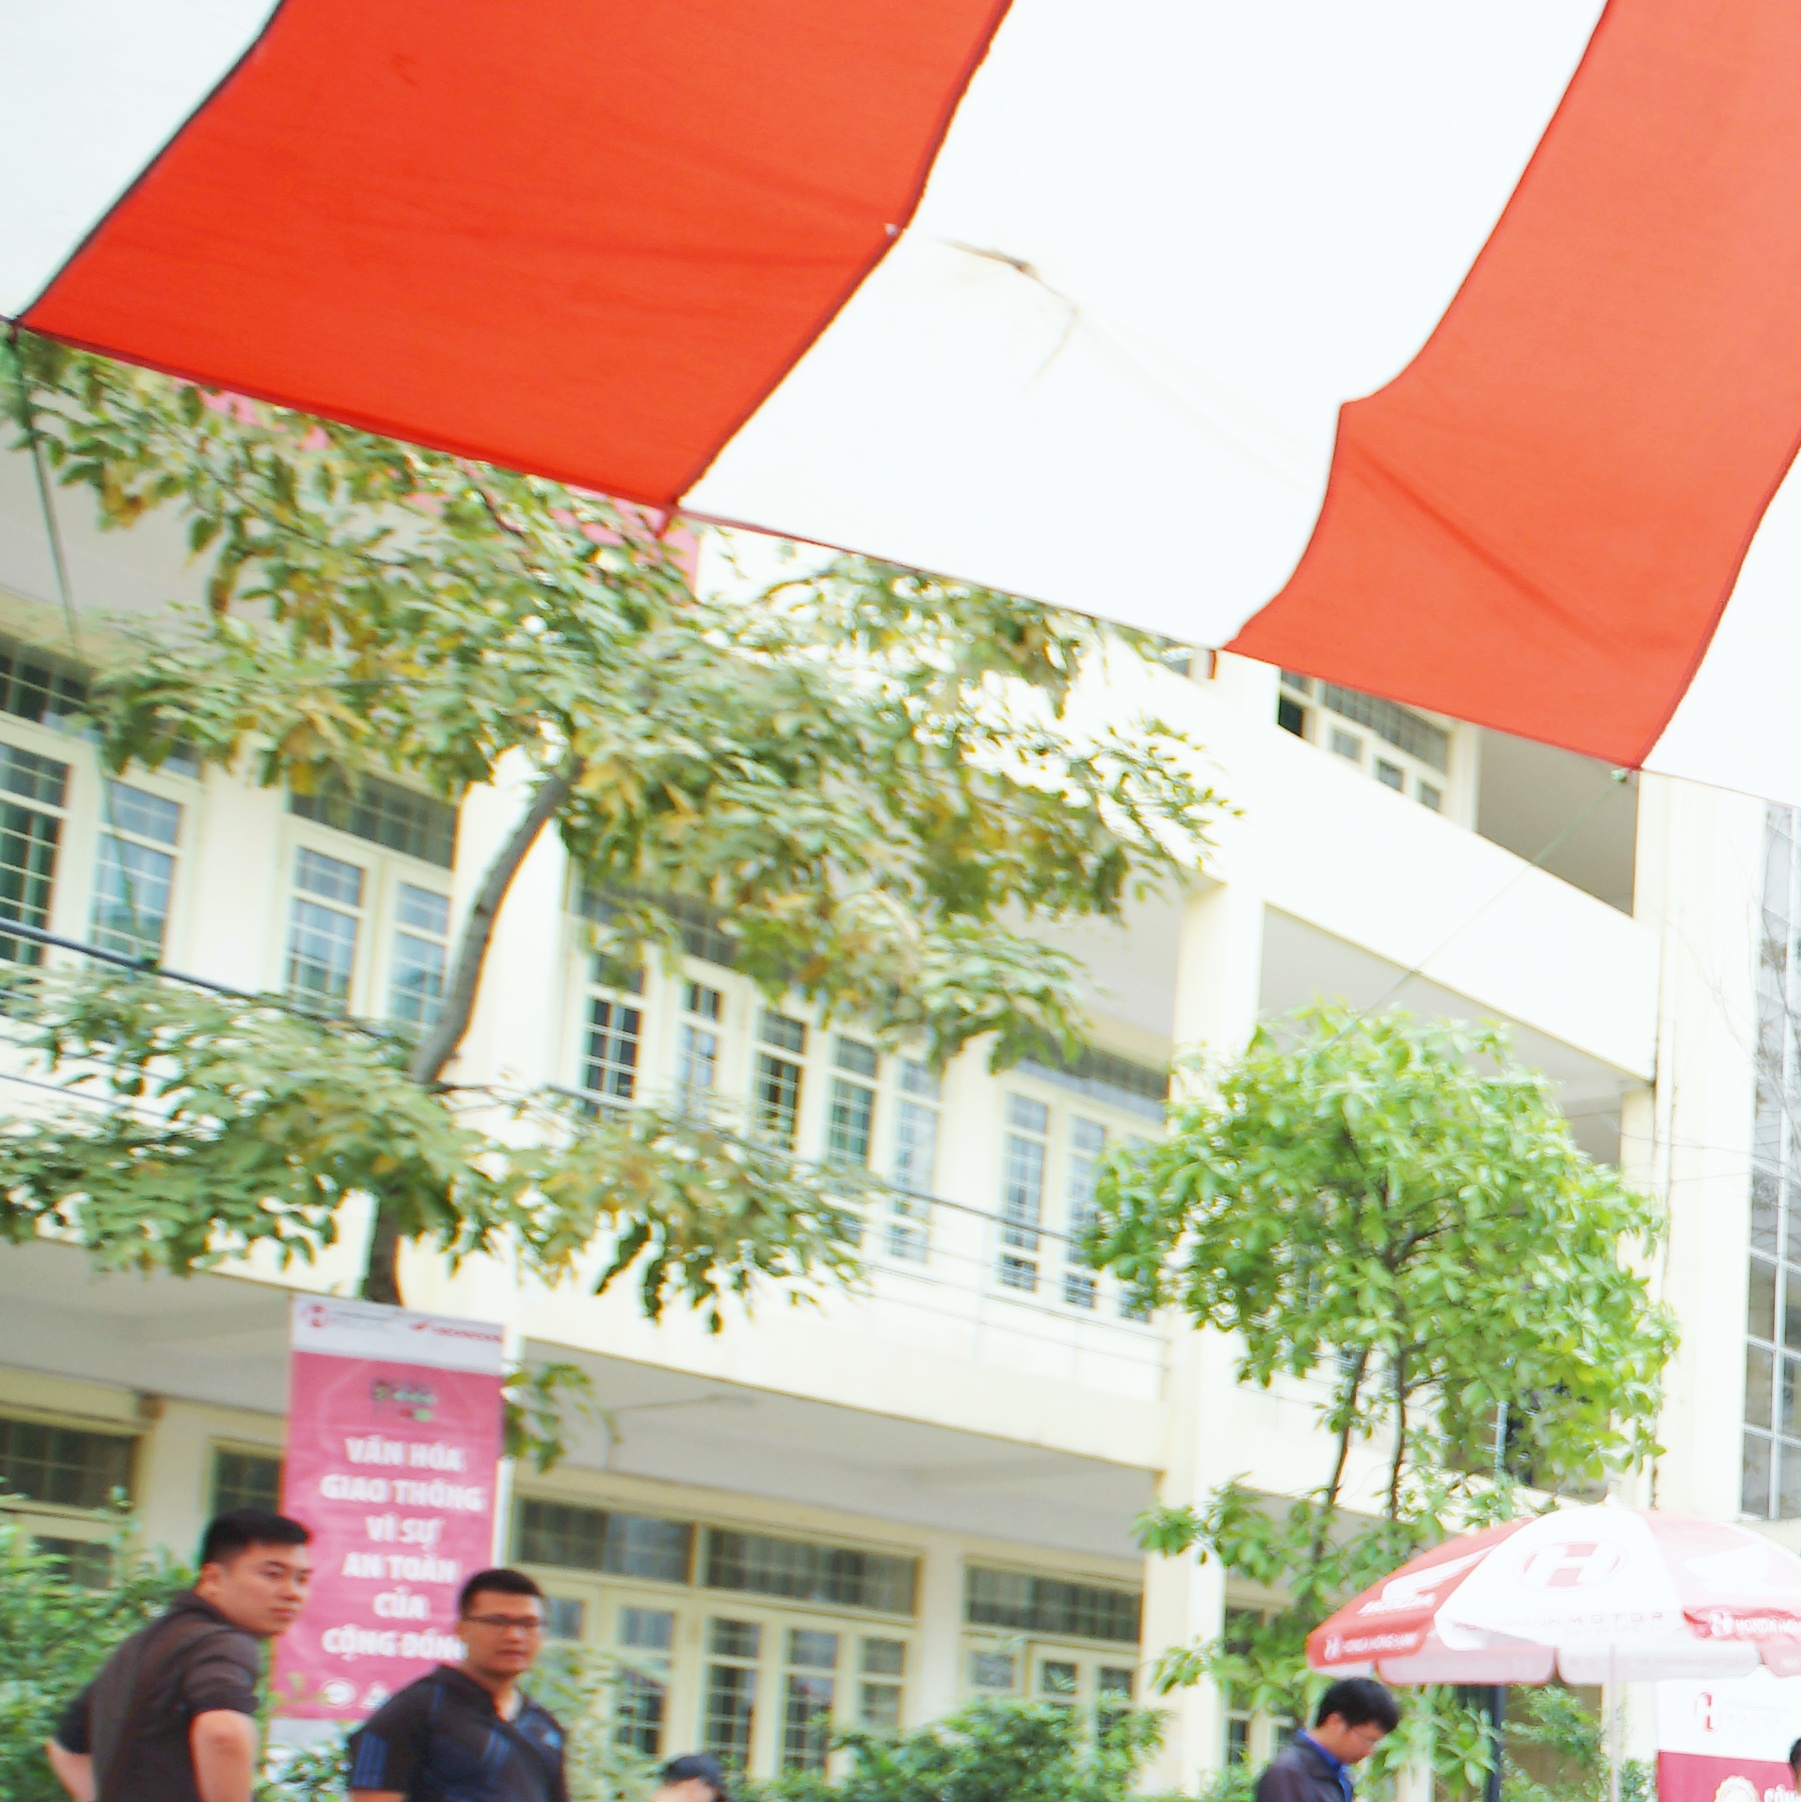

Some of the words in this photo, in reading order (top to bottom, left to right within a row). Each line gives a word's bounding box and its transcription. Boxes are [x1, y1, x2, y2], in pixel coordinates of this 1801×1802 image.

[409, 1442, 463, 1471] HÓA
[320, 1474, 389, 1504] GIAO
[342, 1553, 383, 1579] AN
